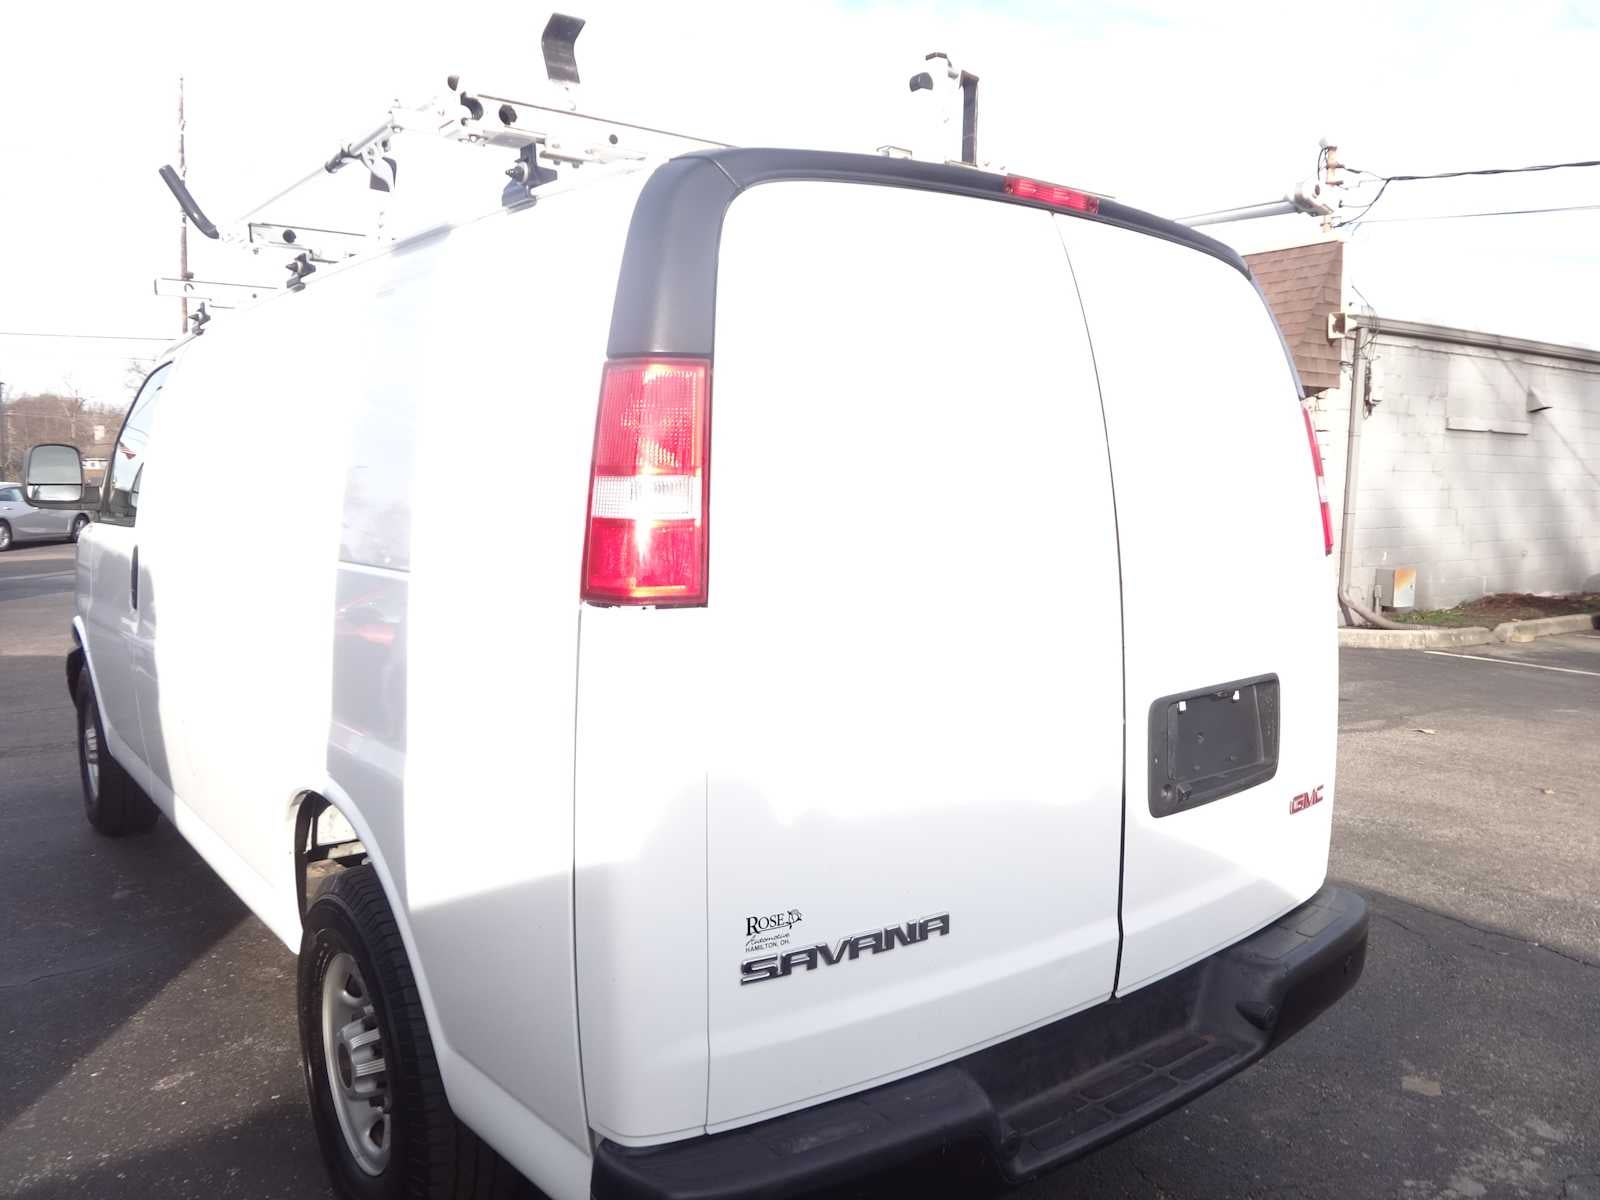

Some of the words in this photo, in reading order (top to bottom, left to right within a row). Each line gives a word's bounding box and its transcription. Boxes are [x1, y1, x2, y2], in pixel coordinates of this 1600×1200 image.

[1290, 784, 1324, 815] GMC
[746, 913, 784, 936] ROSE
[741, 911, 950, 986] SAVANA
[745, 933, 790, 946] Automotive
